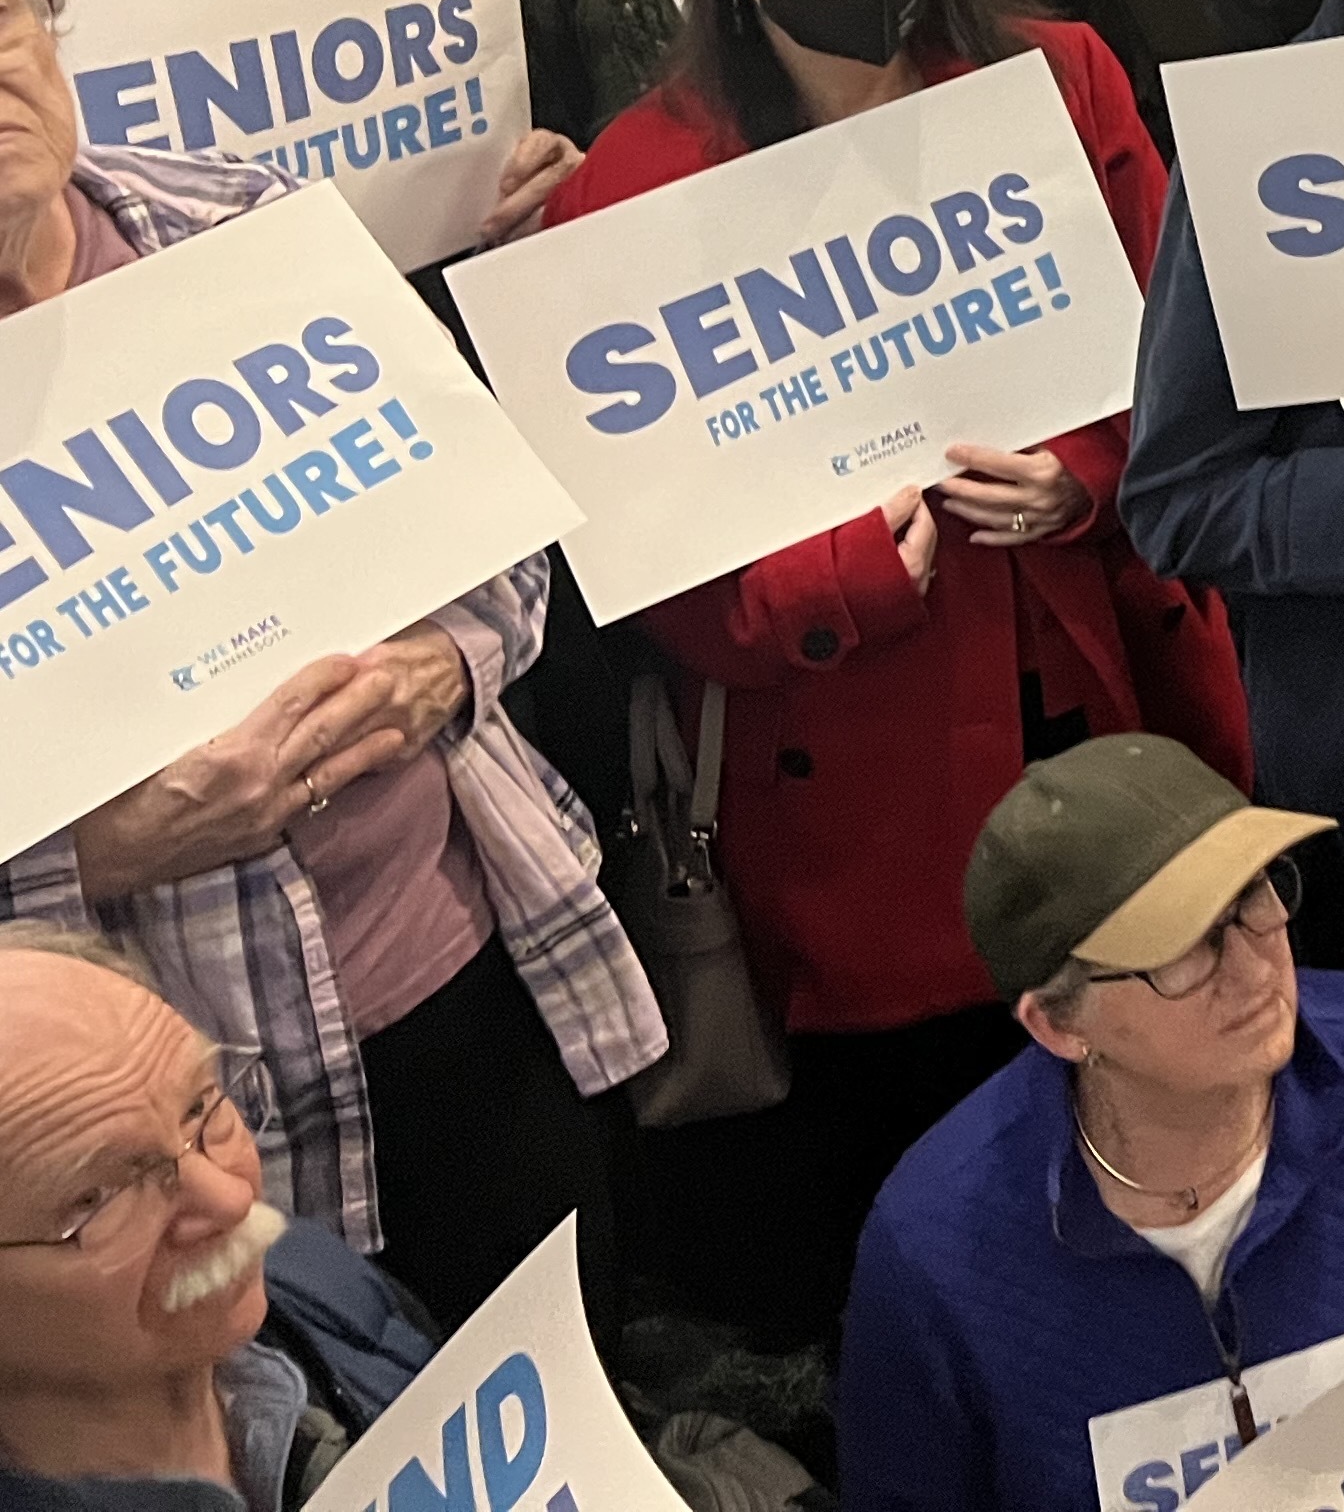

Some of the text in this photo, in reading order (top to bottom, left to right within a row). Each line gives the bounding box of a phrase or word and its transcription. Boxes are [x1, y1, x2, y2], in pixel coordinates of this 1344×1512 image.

[253, 76, 488, 179] UTURE!
[565, 173, 1044, 435] SENIORS
[706, 252, 1071, 447] FOR THE FUTURE!
[0, 317, 380, 610] NIORS
[881, 421, 921, 447] MAKE
[0, 398, 434, 680] FOR THE FUTURE!
[231, 614, 282, 650] MAKE
[363, 1352, 547, 1512] ND
